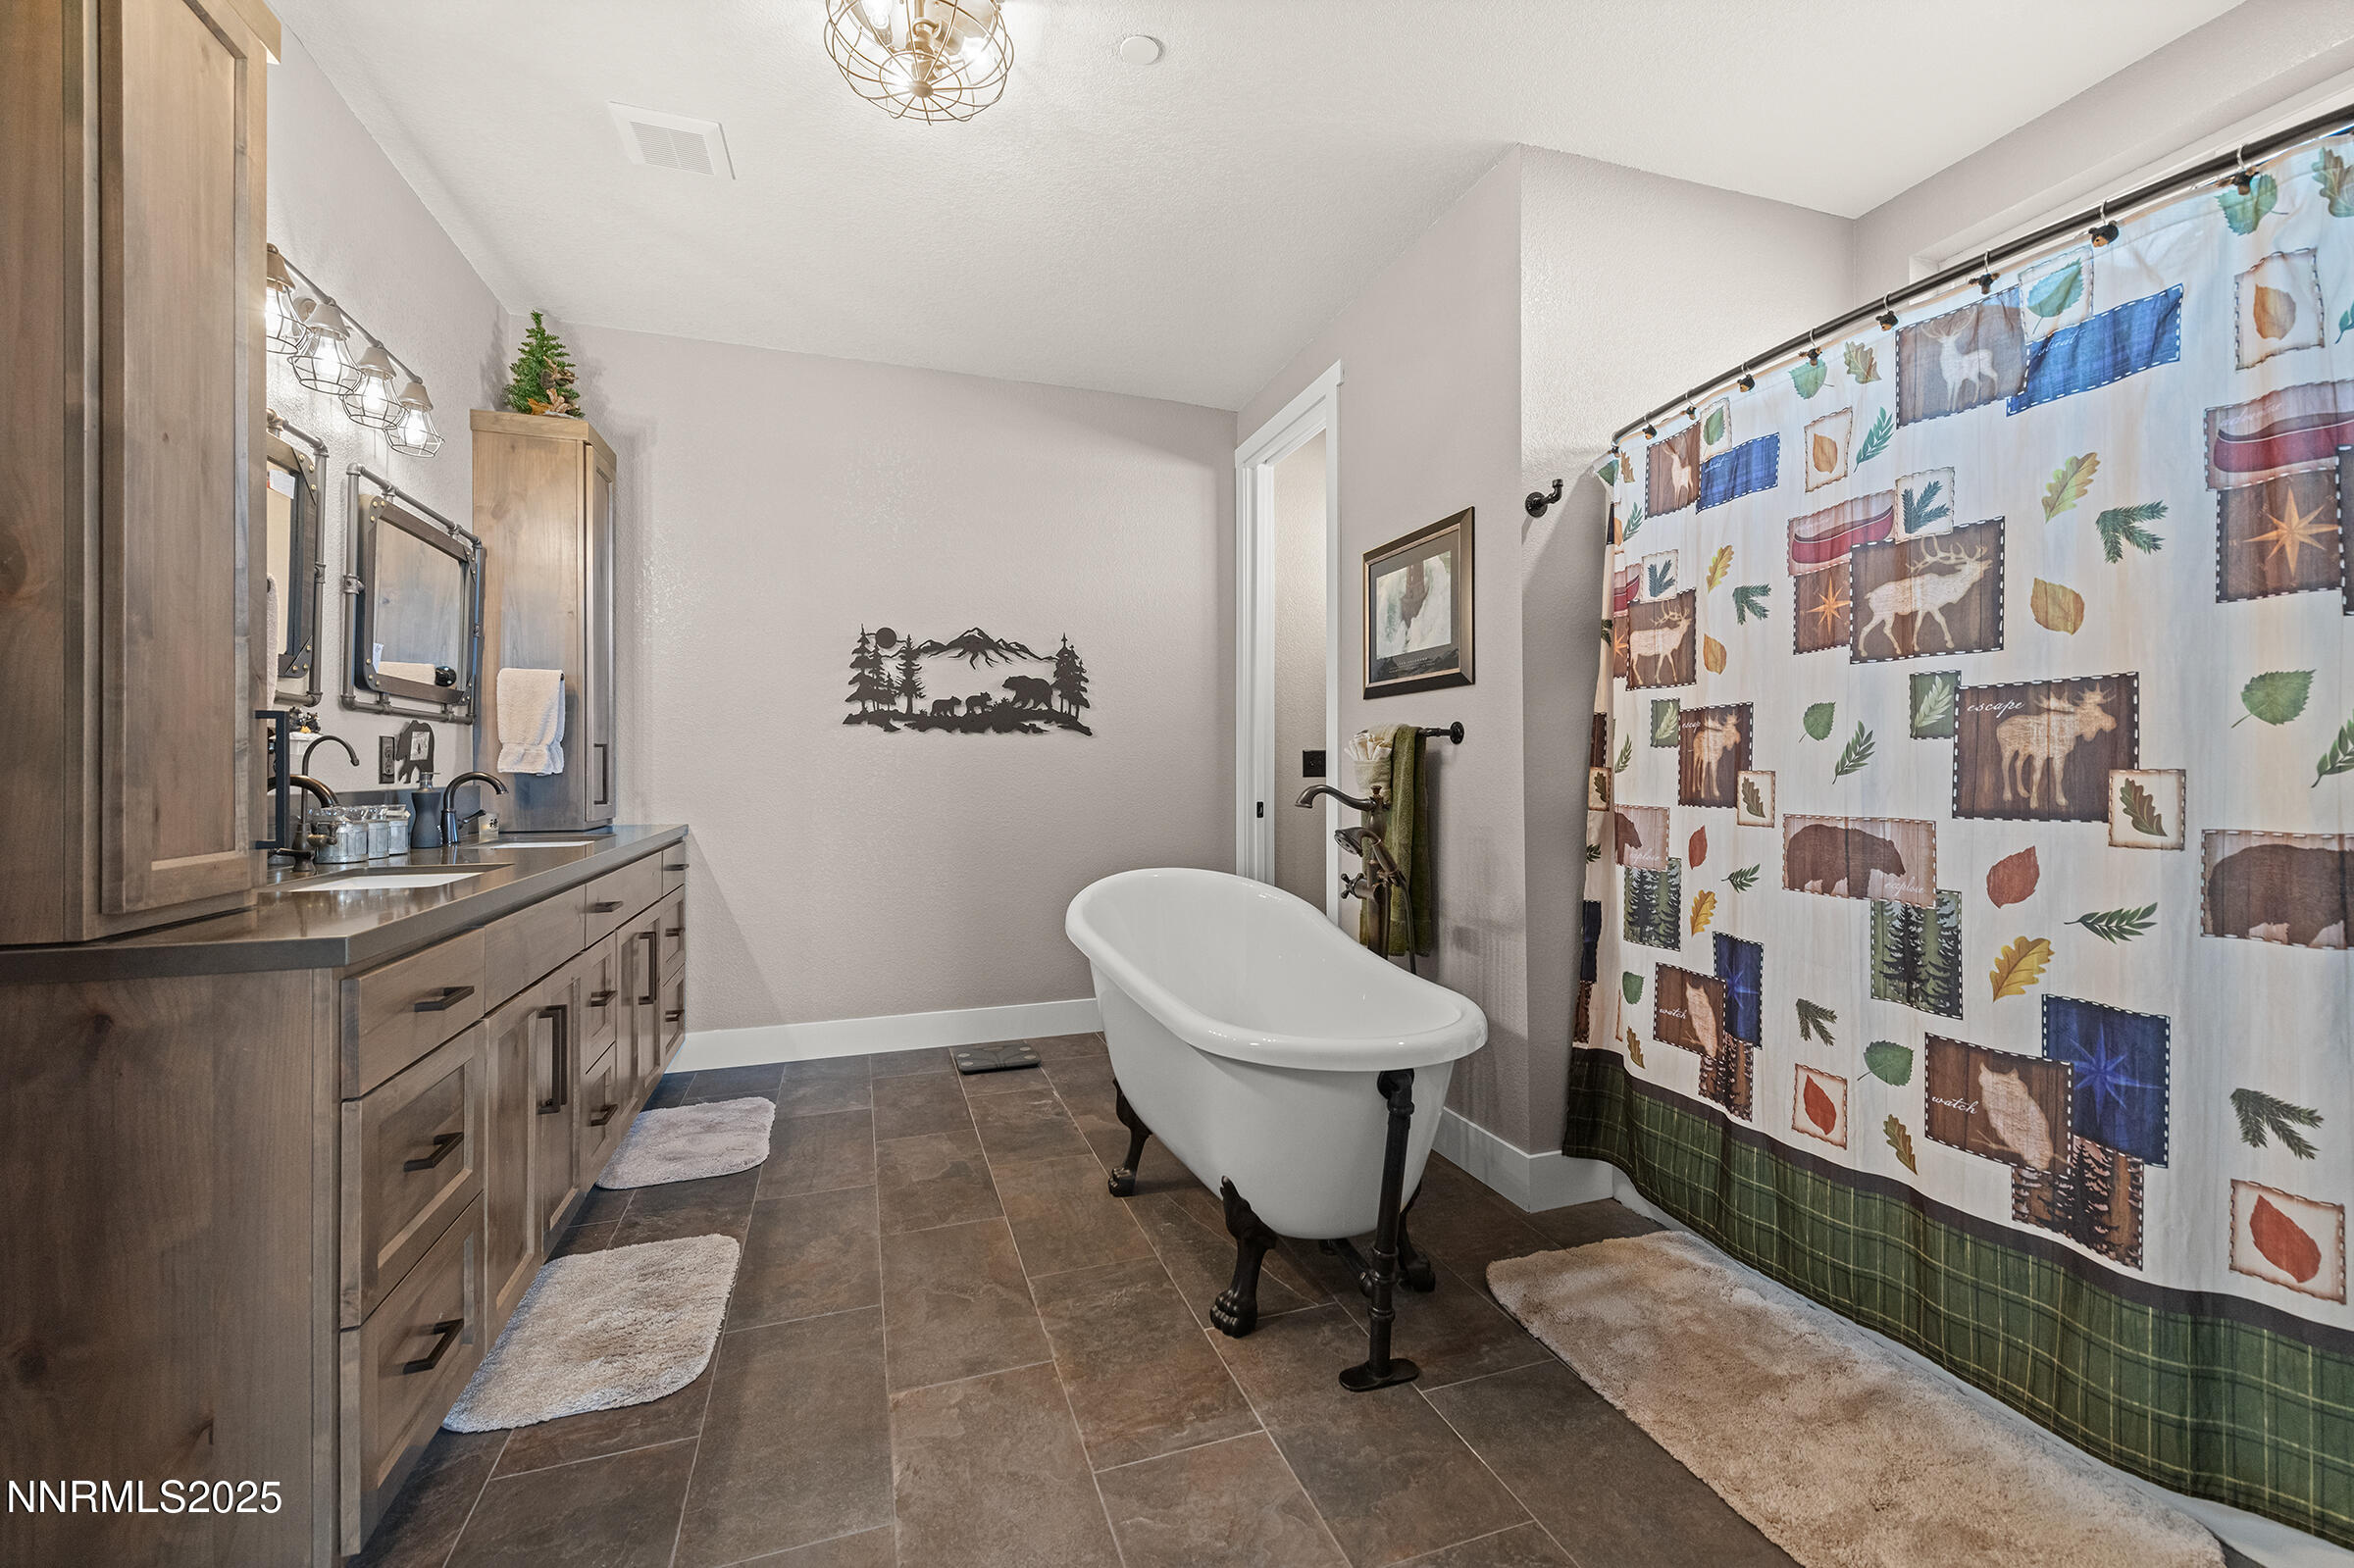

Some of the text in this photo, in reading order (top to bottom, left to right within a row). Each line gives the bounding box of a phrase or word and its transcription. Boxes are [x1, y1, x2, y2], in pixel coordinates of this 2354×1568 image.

[1967, 699, 2025, 719] escape
[1681, 721, 1701, 733] escap
[1659, 1007, 1687, 1020] watch
[1931, 1095, 1979, 1115] watch
